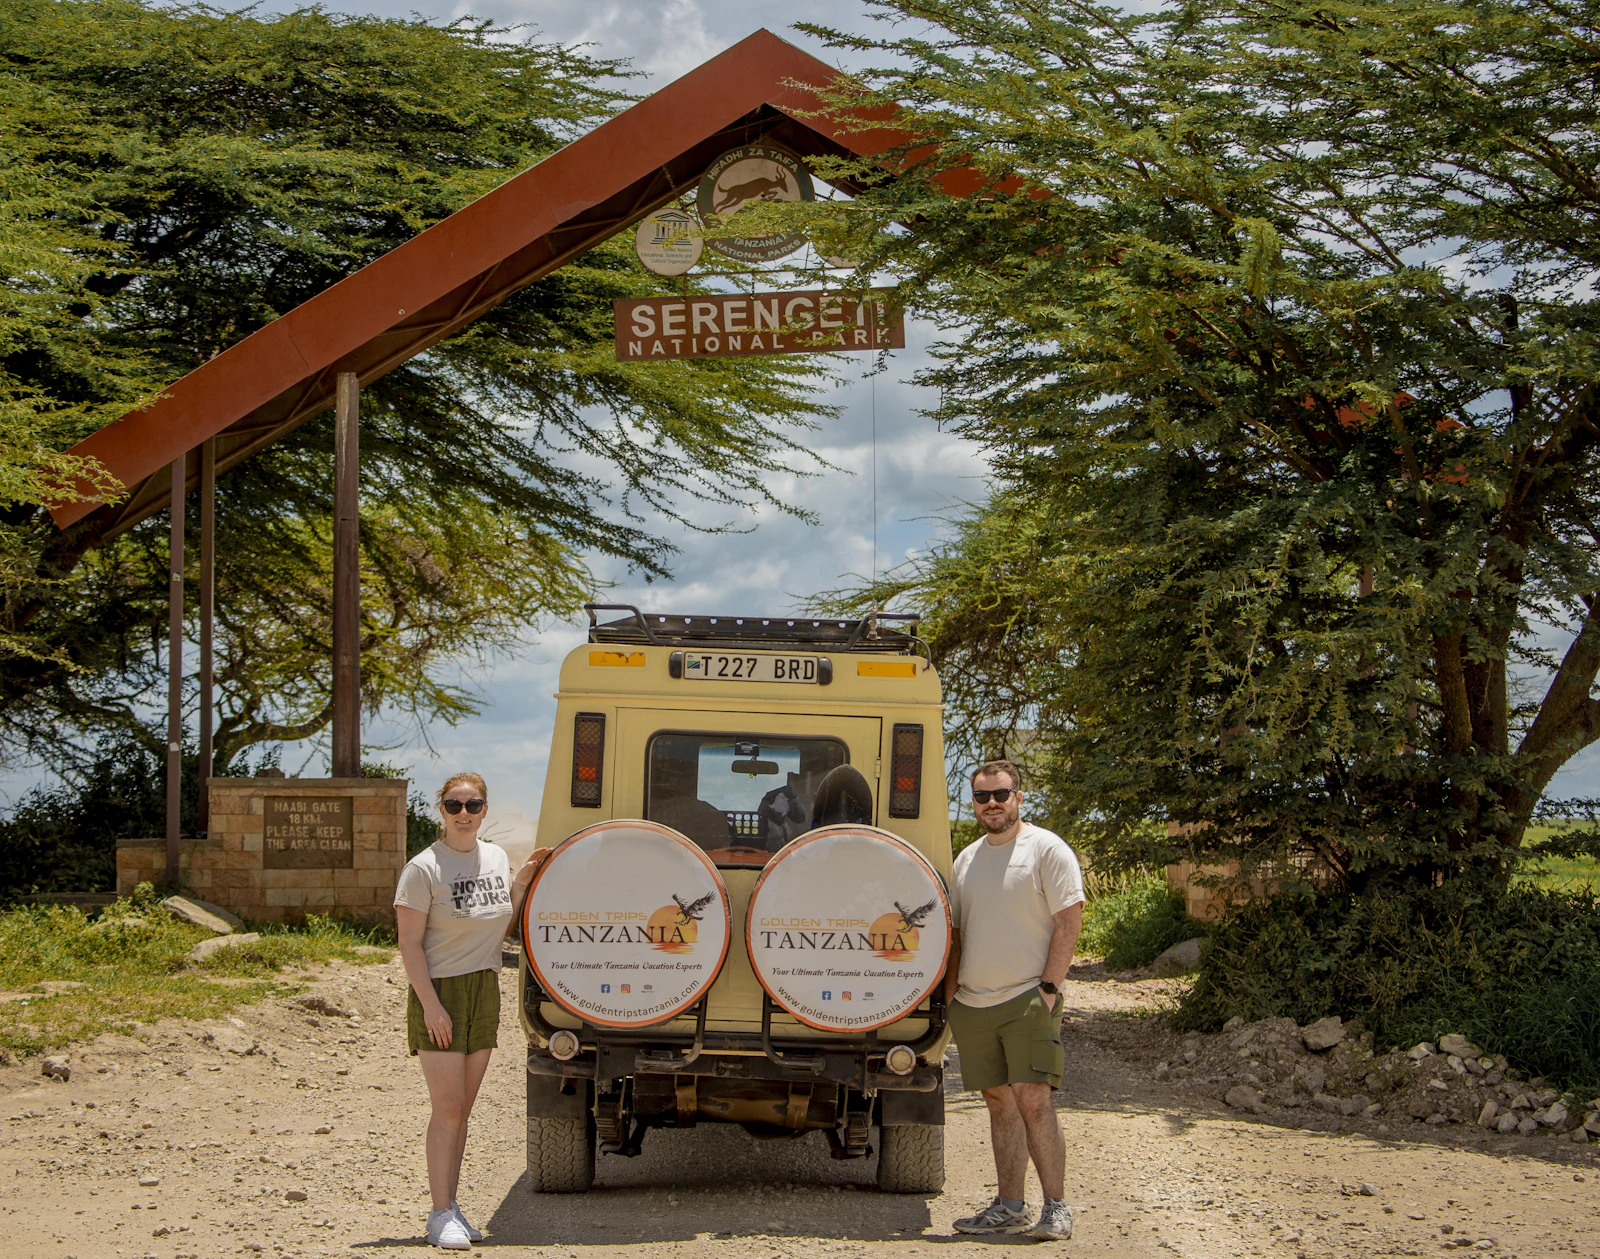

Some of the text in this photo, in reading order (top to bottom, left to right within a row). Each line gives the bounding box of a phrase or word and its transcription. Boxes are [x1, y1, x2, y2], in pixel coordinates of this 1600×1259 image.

[707, 148, 799, 180] HIFADHI ZA TAIFA
[714, 239, 801, 258] NATIONAL PARKS
[734, 236, 783, 247] TANZANIA
[631, 296, 885, 337] SERENGETI
[628, 334, 784, 356] NATIONAL
[701, 656, 815, 680] T 227 BRD
[274, 802, 340, 812] NAABI GATE
[289, 813, 300, 824] 18
[266, 826, 343, 838] PLEASE KEEP
[266, 838, 285, 850] THE
[320, 840, 351, 850] CLEAN
[449, 876, 505, 896] WORLD
[450, 891, 503, 909] TOUR
[538, 911, 647, 921] GOLDEN TRIPS
[760, 917, 869, 928] GOLDEN TRIPS
[538, 925, 687, 943] TANZANIA
[760, 931, 908, 951] TANZANIA
[551, 961, 702, 972] Your Ultimate Tanzania Vacation Experts
[772, 967, 924, 980] Your Ultimate Tanzania Vacation Experts
[557, 979, 700, 1019] www.goldentripstanzania.com
[778, 986, 921, 1026] www.goldentripstanzania.com
